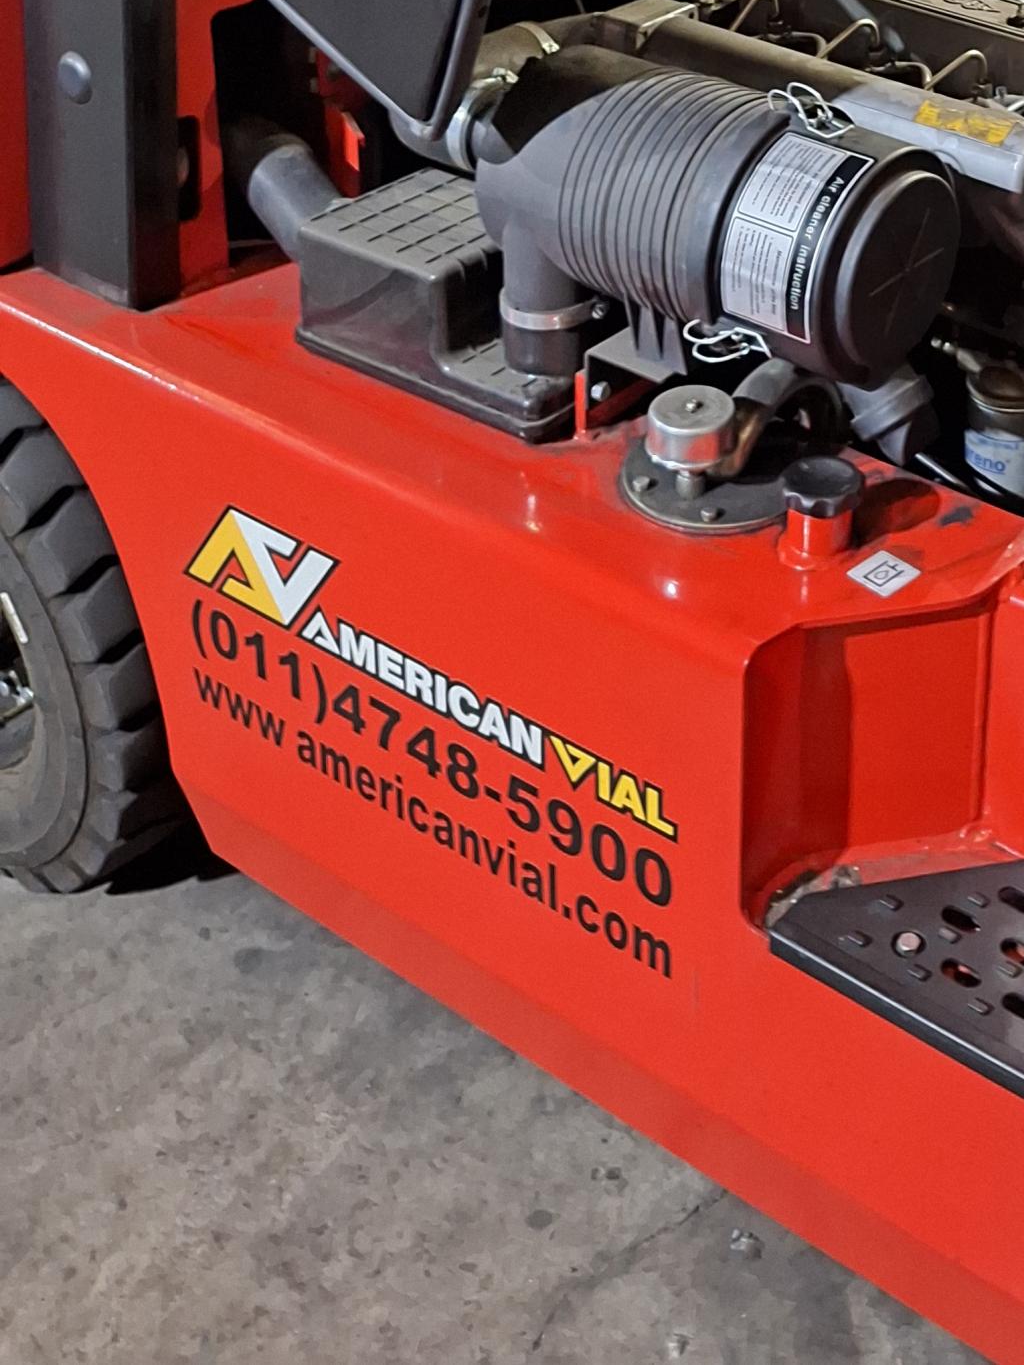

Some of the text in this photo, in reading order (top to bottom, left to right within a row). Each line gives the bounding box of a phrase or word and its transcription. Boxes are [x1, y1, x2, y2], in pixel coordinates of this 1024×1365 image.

[789, 176, 845, 311] Air cleaner instruction
[192, 599, 671, 907] (011)4748-5900
[298, 606, 678, 842] AMERICAN VIAL
